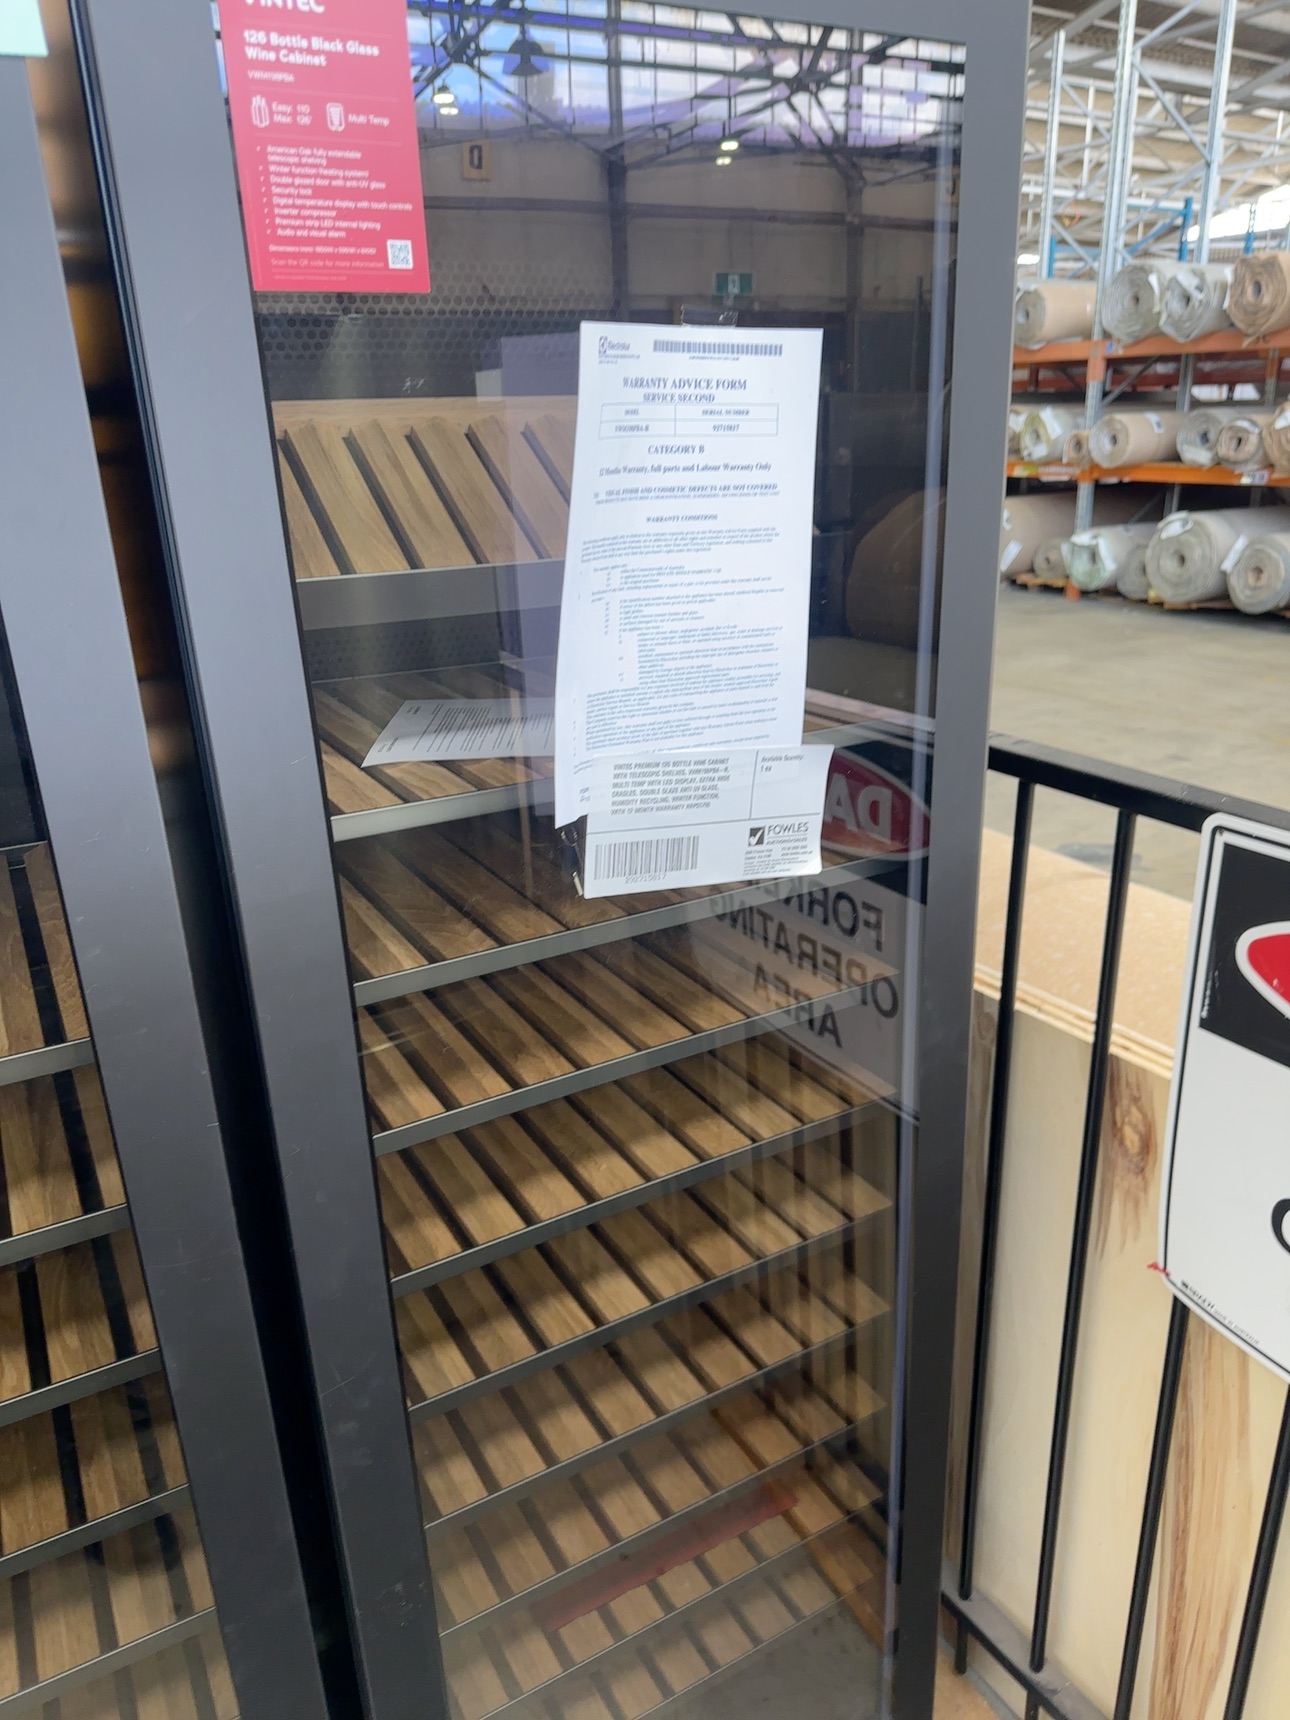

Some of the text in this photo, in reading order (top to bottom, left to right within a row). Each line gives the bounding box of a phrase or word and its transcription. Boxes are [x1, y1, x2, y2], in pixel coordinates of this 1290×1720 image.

[243, 29, 380, 57] 126 Bottle Black Glass
[244, 45, 328, 67] Wine Cabinet
[348, 113, 390, 127] Multi Temp
[267, 145, 297, 155] American
[299, 147, 312, 156] Oak
[313, 148, 327, 158] fully
[269, 164, 291, 174] Winter
[292, 166, 318, 176] function
[270, 174, 293, 184] Double
[315, 178, 330, 186] door
[331, 179, 345, 187] with
[370, 181, 386, 191] glass
[271, 185, 313, 196] Security lock
[272, 196, 413, 211] Digital temperature display with touch controls
[274, 207, 337, 218] Inverter compressor
[275, 217, 304, 227] Premium
[320, 219, 334, 228] LED
[358, 221, 381, 232] lighting
[271, 258, 287, 266] Scan
[287, 258, 299, 266] the
[299, 258, 310, 268] QR
[325, 260, 334, 268] for
[351, 261, 385, 269] information
[622, 377, 748, 391] WARRANTY ADVICE FORM
[642, 392, 716, 403] SERVICE SECOND
[701, 408, 750, 417] SERIAL NUMBER
[647, 444, 705, 455] CATEGORY B
[622, 465, 650, 475] Warranty,
[650, 463, 662, 473] full
[662, 465, 681, 476] parts
[682, 463, 695, 473] and
[697, 463, 721, 473] Labour
[722, 462, 754, 474] Warranty
[755, 461, 773, 472] Only
[634, 761, 661, 770] PREMIUM
[672, 759, 692, 769] BOTTLE
[693, 759, 708, 768] WINE
[708, 757, 730, 767] CABINET
[761, 755, 783, 763] Available
[613, 772, 628, 780] WITH
[629, 770, 661, 779] TELESCOPIC
[612, 780, 630, 789] MULTI
[631, 780, 647, 788] TEMP
[662, 778, 674, 787] LED
[699, 776, 716, 784] EXTRA
[639, 788, 661, 796] DOUBLE
[661, 786, 679, 795] GLAZE
[680, 785, 692, 793] ANTI
[611, 799, 638, 808] HUMIDITY
[671, 795, 692, 804] WINTER
[611, 808, 626, 816] WITH
[634, 806, 655, 814] MONTH
[655, 803, 685, 813] WARRANTY
[766, 821, 810, 837] FOWLES
